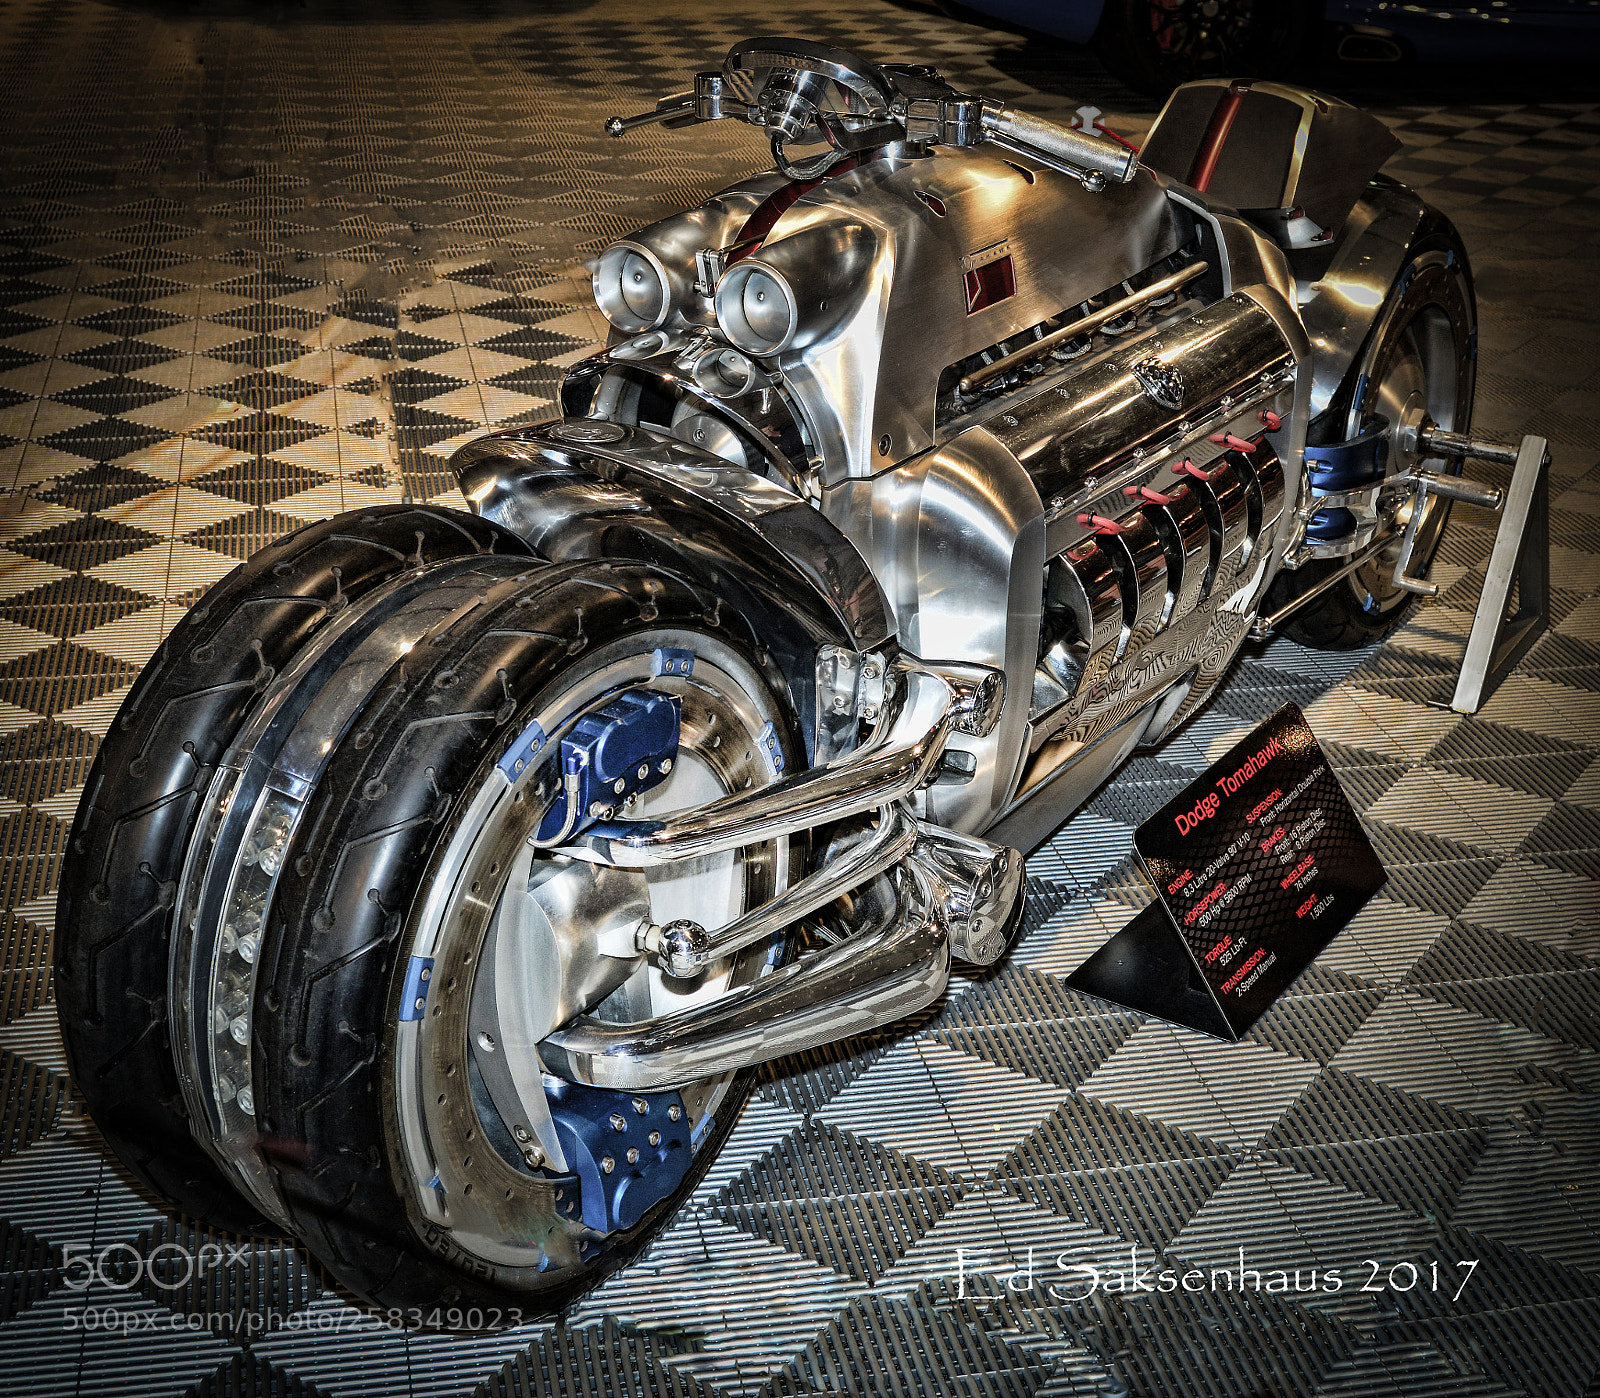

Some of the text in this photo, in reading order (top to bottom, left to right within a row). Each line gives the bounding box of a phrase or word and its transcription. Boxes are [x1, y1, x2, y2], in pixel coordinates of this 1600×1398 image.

[1174, 736, 1284, 837] Dodge Tomahawk
[1274, 788, 1299, 814] Horizontal
[1297, 774, 1315, 793] Double
[1312, 764, 1326, 778] Fork
[1261, 827, 1287, 853] BRAKES:
[1289, 829, 1298, 841] 16
[1295, 817, 1313, 835] Piston
[1310, 807, 1323, 821] Disc
[1295, 841, 1302, 850] 8
[1299, 828, 1317, 846] Piston
[1313, 818, 1327, 832] Disc
[1183, 883, 1195, 898] 8.3
[1193, 873, 1208, 889] Litre
[1205, 853, 1230, 877] 20-Valve
[1236, 832, 1251, 847] V-10
[1294, 866, 1319, 892] 76 Inches
[1184, 882, 1228, 926] HORSEPOWER:
[1198, 911, 1212, 927] 500
[1209, 904, 1221, 917] Hp
[1223, 885, 1239, 904] 5600
[1237, 872, 1253, 891] RPM
[1310, 893, 1335, 921] 1,500 Lbs
[1219, 936, 1248, 967] 525 Lb-Ft
[1220, 947, 1267, 995] TRANSMISSION:
[1235, 951, 1277, 998] 2-Speed Manual
